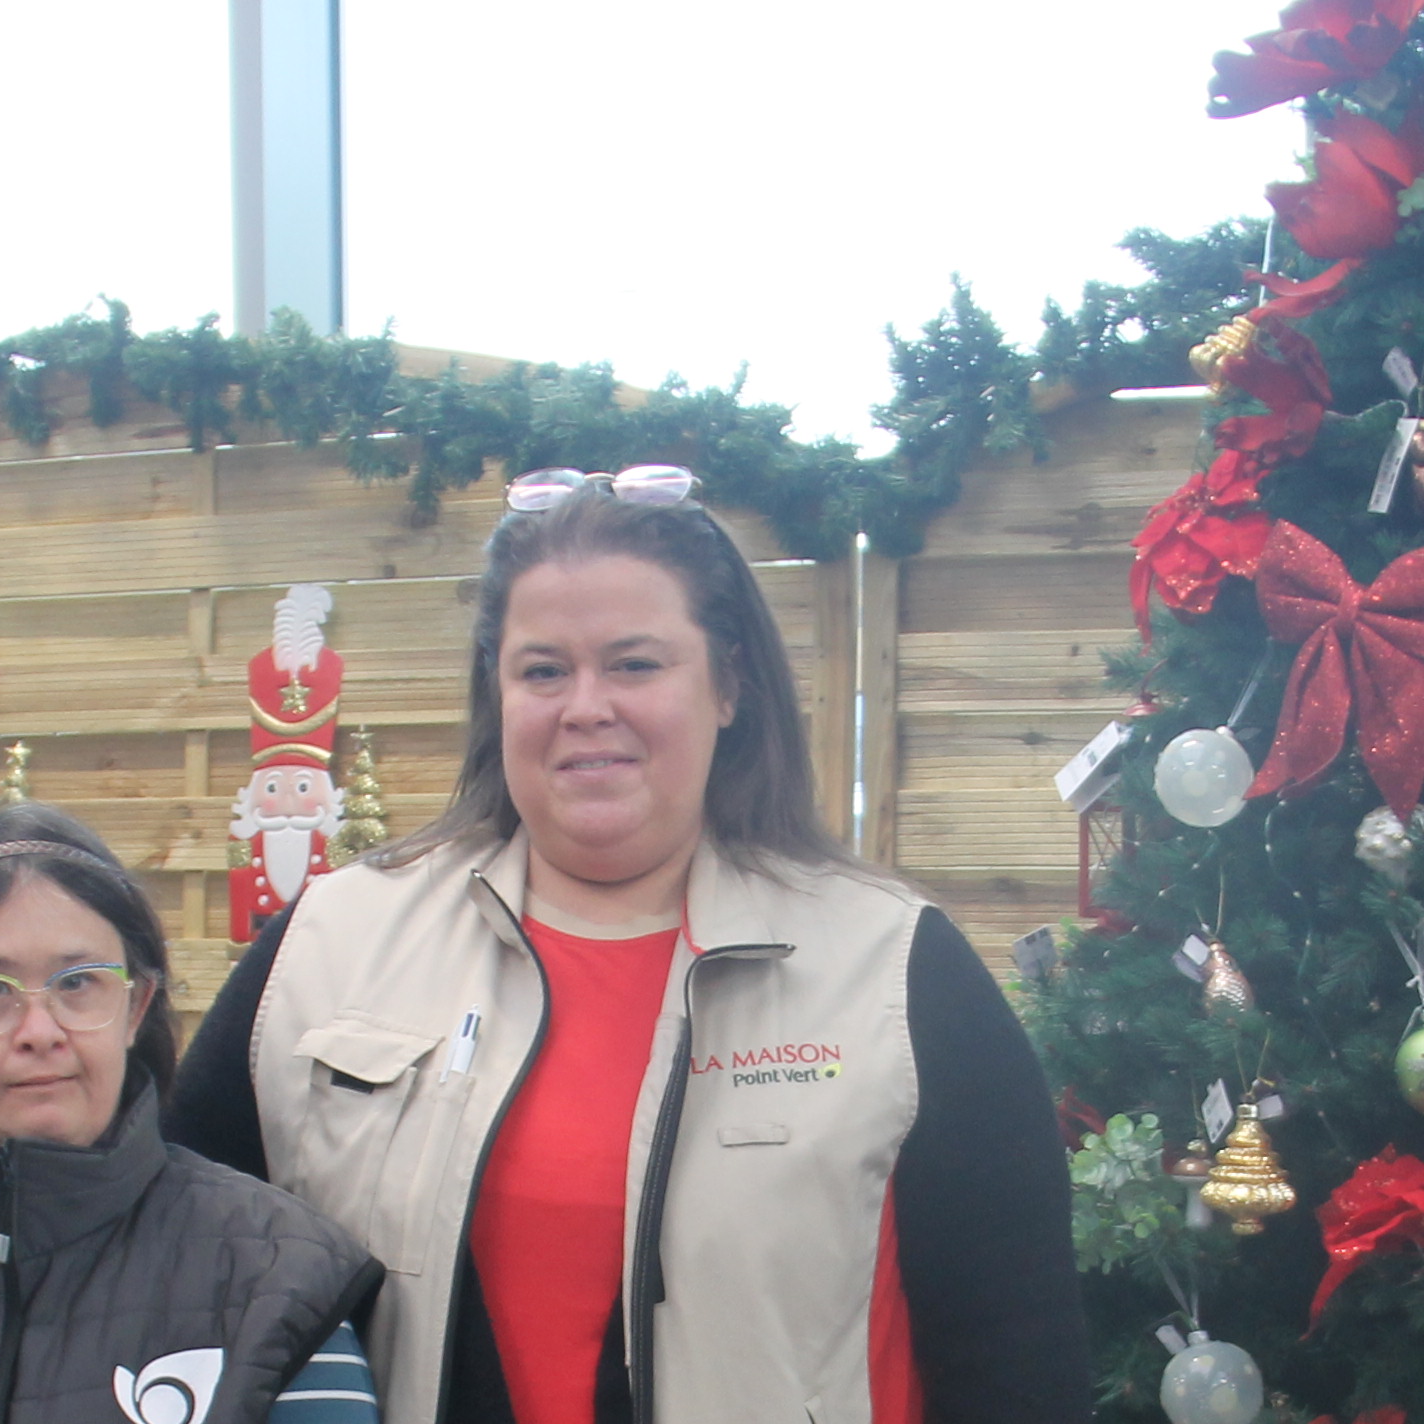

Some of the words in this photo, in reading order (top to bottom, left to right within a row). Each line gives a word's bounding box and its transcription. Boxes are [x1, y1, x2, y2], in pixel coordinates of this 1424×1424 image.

[691, 1056, 724, 1074] LA
[732, 1044, 841, 1068] MAISON
[733, 1070, 781, 1087] Point
[782, 1069, 819, 1082] Vert
